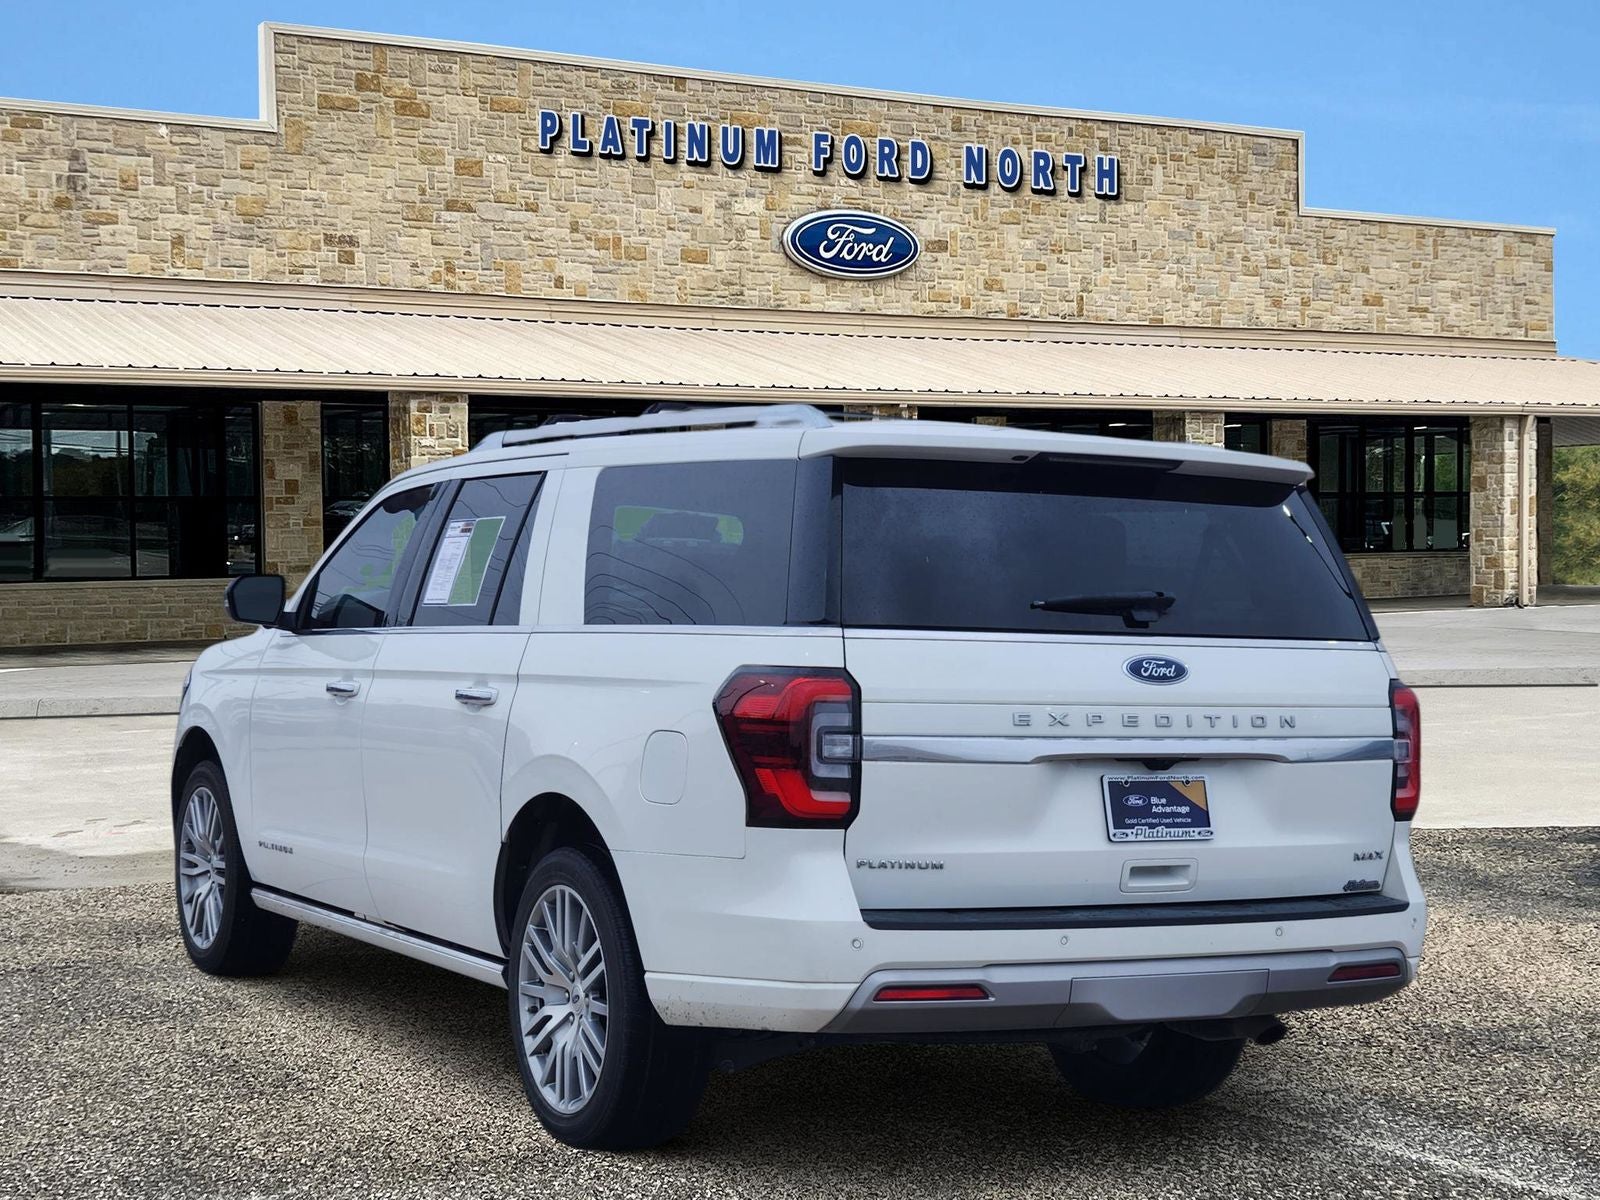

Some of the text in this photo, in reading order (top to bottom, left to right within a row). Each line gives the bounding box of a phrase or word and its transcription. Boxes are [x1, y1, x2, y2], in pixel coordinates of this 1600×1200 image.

[538, 109, 1120, 200] PLATINUM FORD NORTH
[818, 222, 897, 264] Ford
[1140, 659, 1177, 678] Ford
[1011, 711, 1298, 729] EXPEDITION
[1150, 796, 1167, 805] Blue
[1151, 805, 1190, 814] Advantage
[1134, 826, 1192, 839] Platinum
[1353, 850, 1385, 862] MAX
[856, 859, 945, 870] PLATINUM
